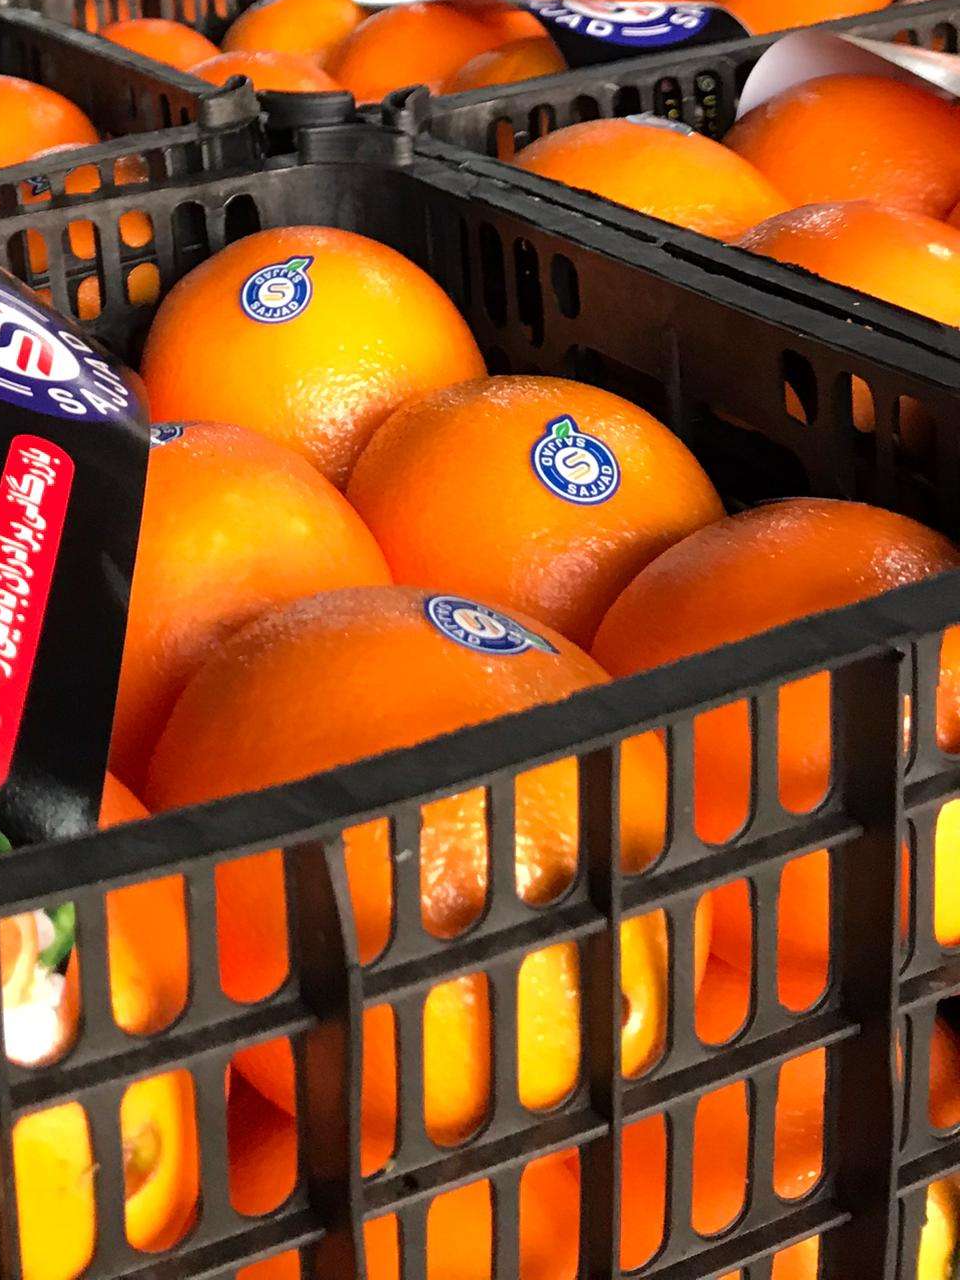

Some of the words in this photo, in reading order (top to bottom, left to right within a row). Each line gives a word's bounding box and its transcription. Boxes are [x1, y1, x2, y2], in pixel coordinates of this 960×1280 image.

[249, 300, 299, 318] SAJJAD
[47, 330, 129, 416] SAJJAD
[541, 436, 586, 466] SAJJAD
[5, 447, 61, 530] بازرگانی
[567, 465, 613, 497] SAJJAD
